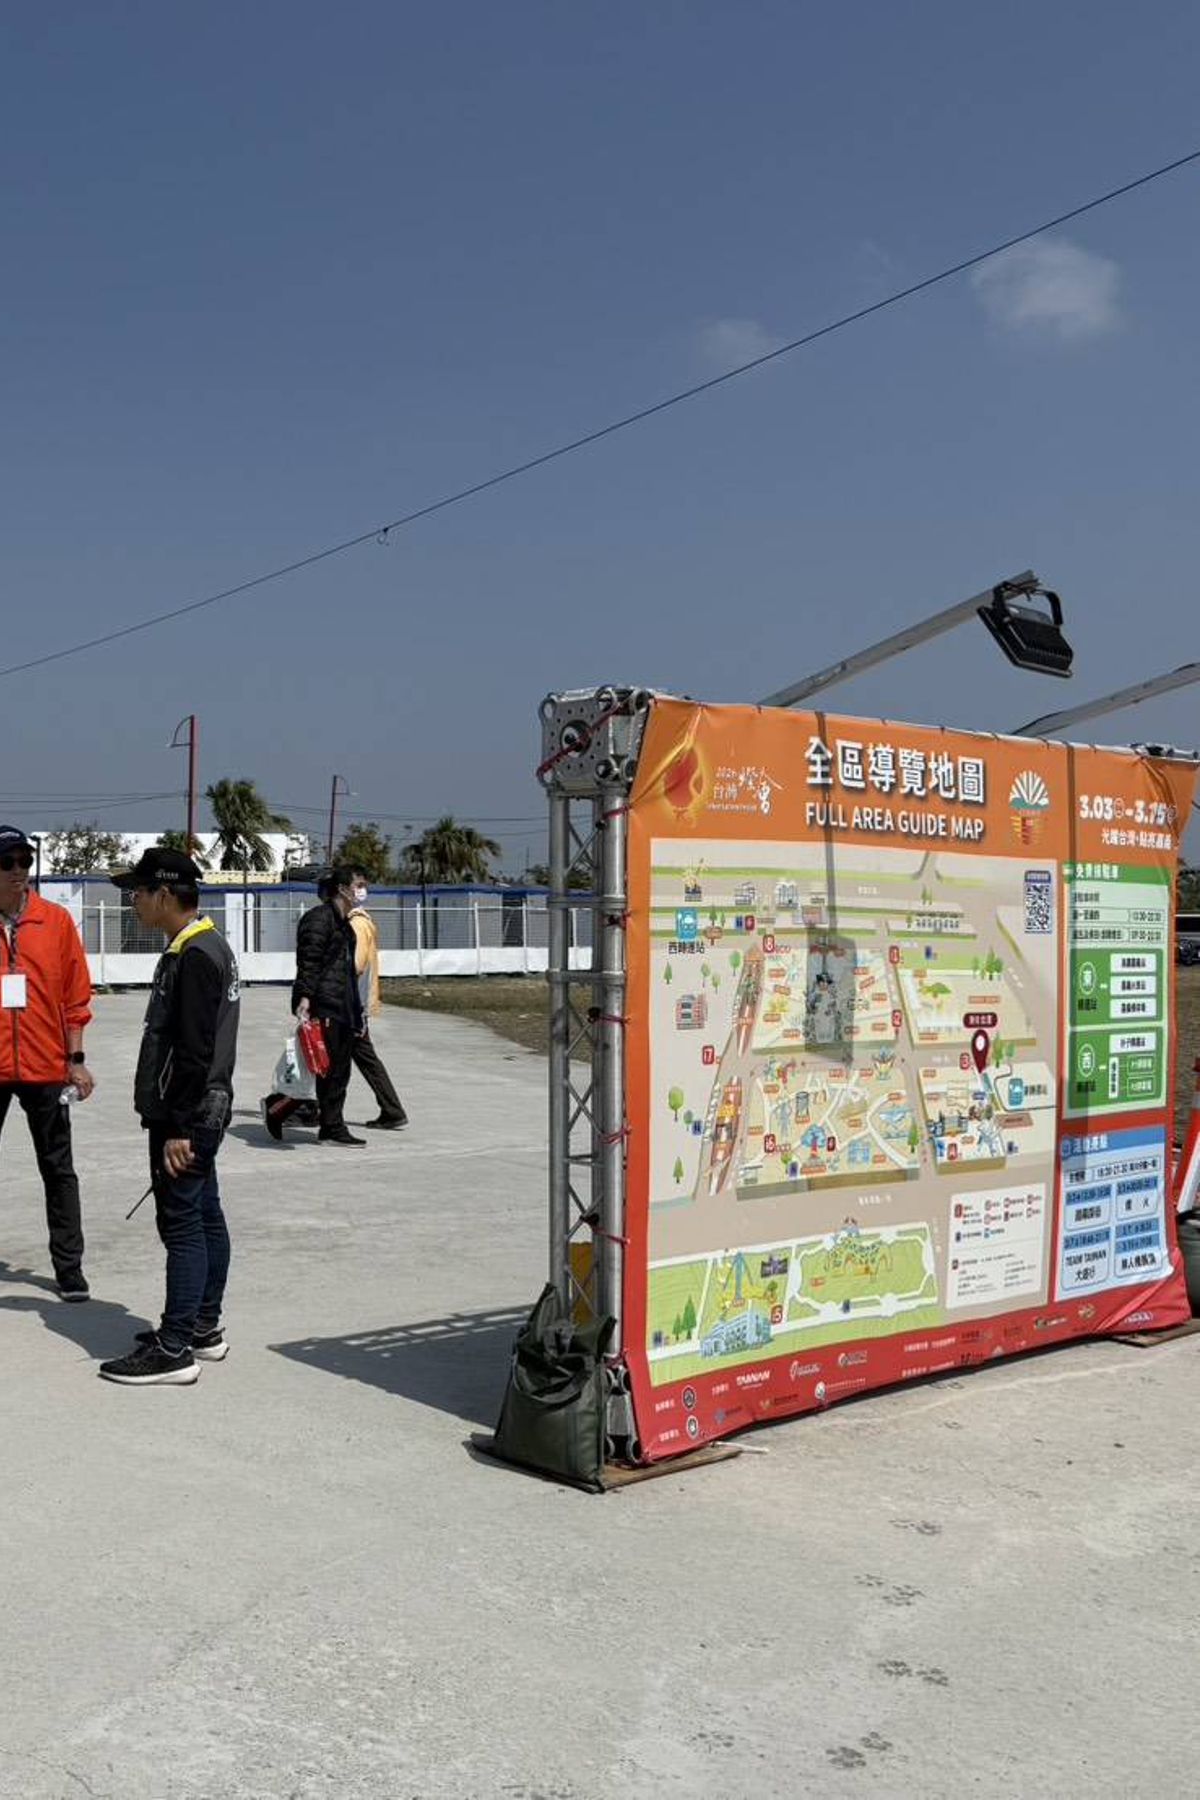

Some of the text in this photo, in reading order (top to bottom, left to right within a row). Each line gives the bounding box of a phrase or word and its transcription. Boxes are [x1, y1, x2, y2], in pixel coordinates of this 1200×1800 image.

[805, 736, 985, 804] 全區導覽地圖
[806, 803, 985, 840] FULL AREA GUIDE MAP
